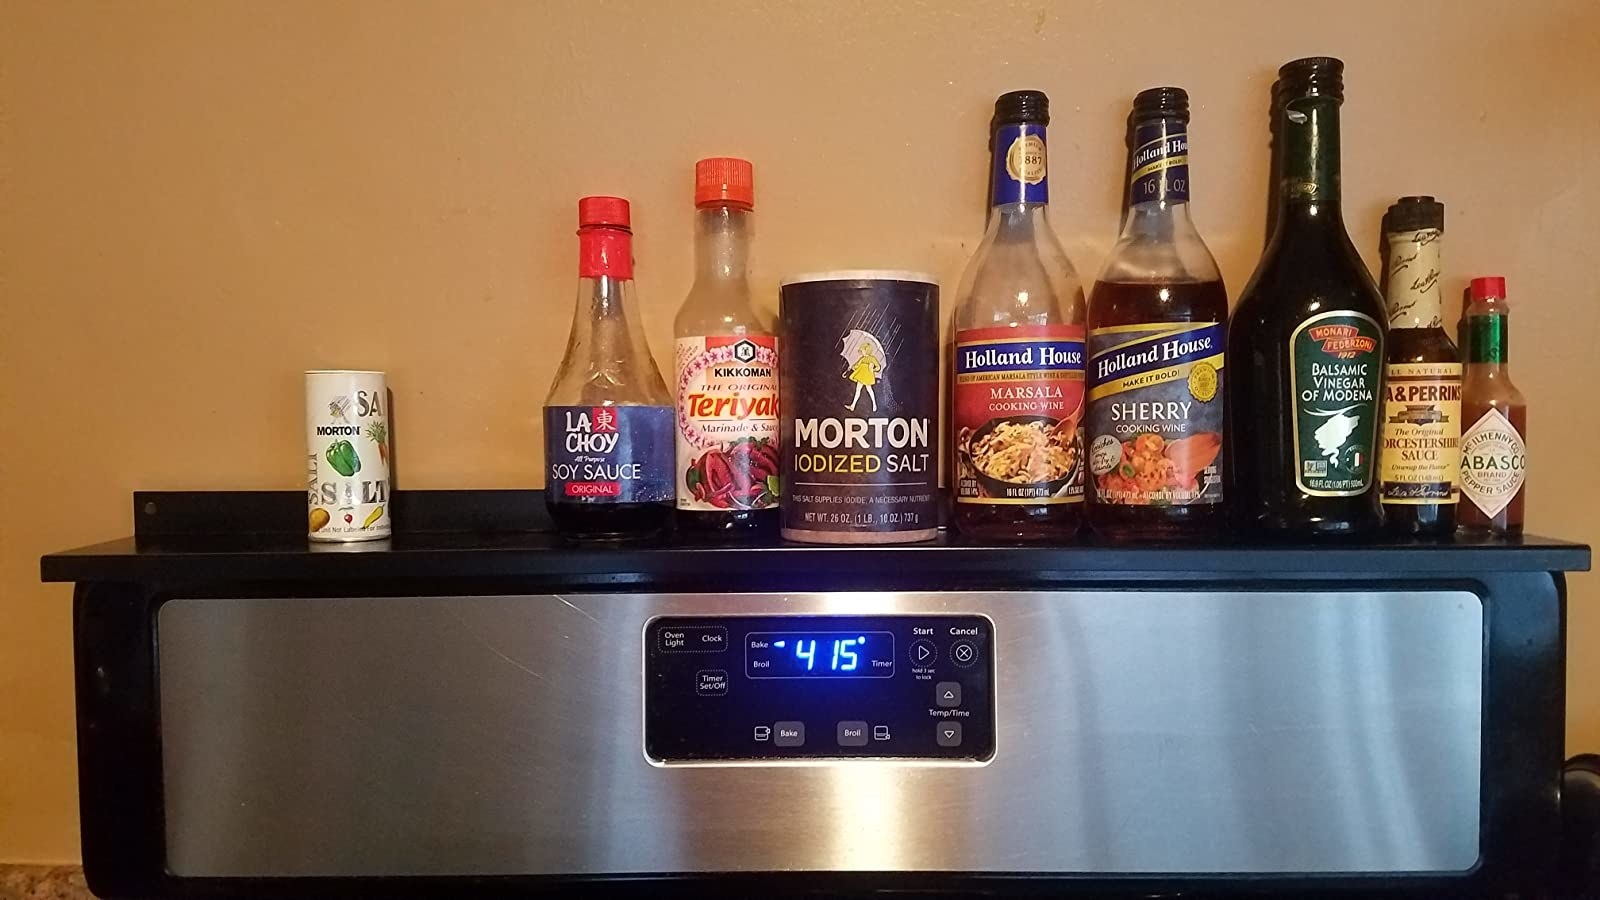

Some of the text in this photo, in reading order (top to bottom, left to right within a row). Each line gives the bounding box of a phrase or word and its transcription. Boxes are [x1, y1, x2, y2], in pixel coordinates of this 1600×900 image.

[1133, 143, 1170, 169] Holland
[1144, 179, 1155, 194] 16
[1173, 179, 1185, 192] OZ
[1316, 328, 1352, 337] MONARI
[1328, 338, 1372, 350] FEDERZONI
[965, 347, 1081, 369] Holland House
[1098, 337, 1211, 379] Holland House
[1338, 351, 1356, 359] 1912
[714, 368, 771, 377] KIKKOMAN
[1312, 363, 1367, 376] BALSAMIC
[1123, 370, 1180, 388] MAKE IT BOLD!
[1313, 377, 1365, 389] VINEGAR
[990, 387, 1063, 399] MARSALA
[1302, 390, 1372, 401] OF MODENA
[989, 402, 1064, 411] COOKING WINE
[1112, 401, 1192, 421] SHERRY
[566, 411, 592, 433] LA
[595, 410, 616, 431] 東
[317, 426, 360, 436] MORTON
[701, 423, 748, 433] Marinade
[1116, 424, 1186, 433] COOKING WINE
[1411, 428, 1444, 436] Original
[795, 418, 928, 449] MORTON
[566, 432, 619, 453] CHOY
[1402, 450, 1438, 461] SAUCE
[795, 454, 929, 473] IODIZED SALT
[552, 464, 641, 480] SOY SAUCE
[1462, 470, 1519, 494] PEPPER SAUCE
[572, 485, 613, 493] ORIGINAL
[815, 496, 842, 504] SUPPLIES
[875, 496, 908, 504] NECESSARY
[805, 513, 815, 522] NET
[817, 513, 829, 522] WT.
[831, 514, 838, 523] 26
[840, 514, 853, 523] OZ.
[854, 514, 861, 524] (1
[904, 513, 914, 522] 737
[664, 632, 685, 640] Oven
[913, 627, 933, 635] Start
[950, 627, 978, 635] Cancel
[665, 639, 685, 647] Light
[702, 634, 722, 642] Clock
[751, 641, 768, 649] Bake
[753, 659, 770, 668] Broil
[872, 660, 892, 668] Timer
[702, 675, 723, 683] Timer
[700, 682, 726, 690] Set/Off
[929, 709, 969, 718] Temp/Time
[780, 729, 798, 738] Bake
[844, 729, 861, 737] Broil
